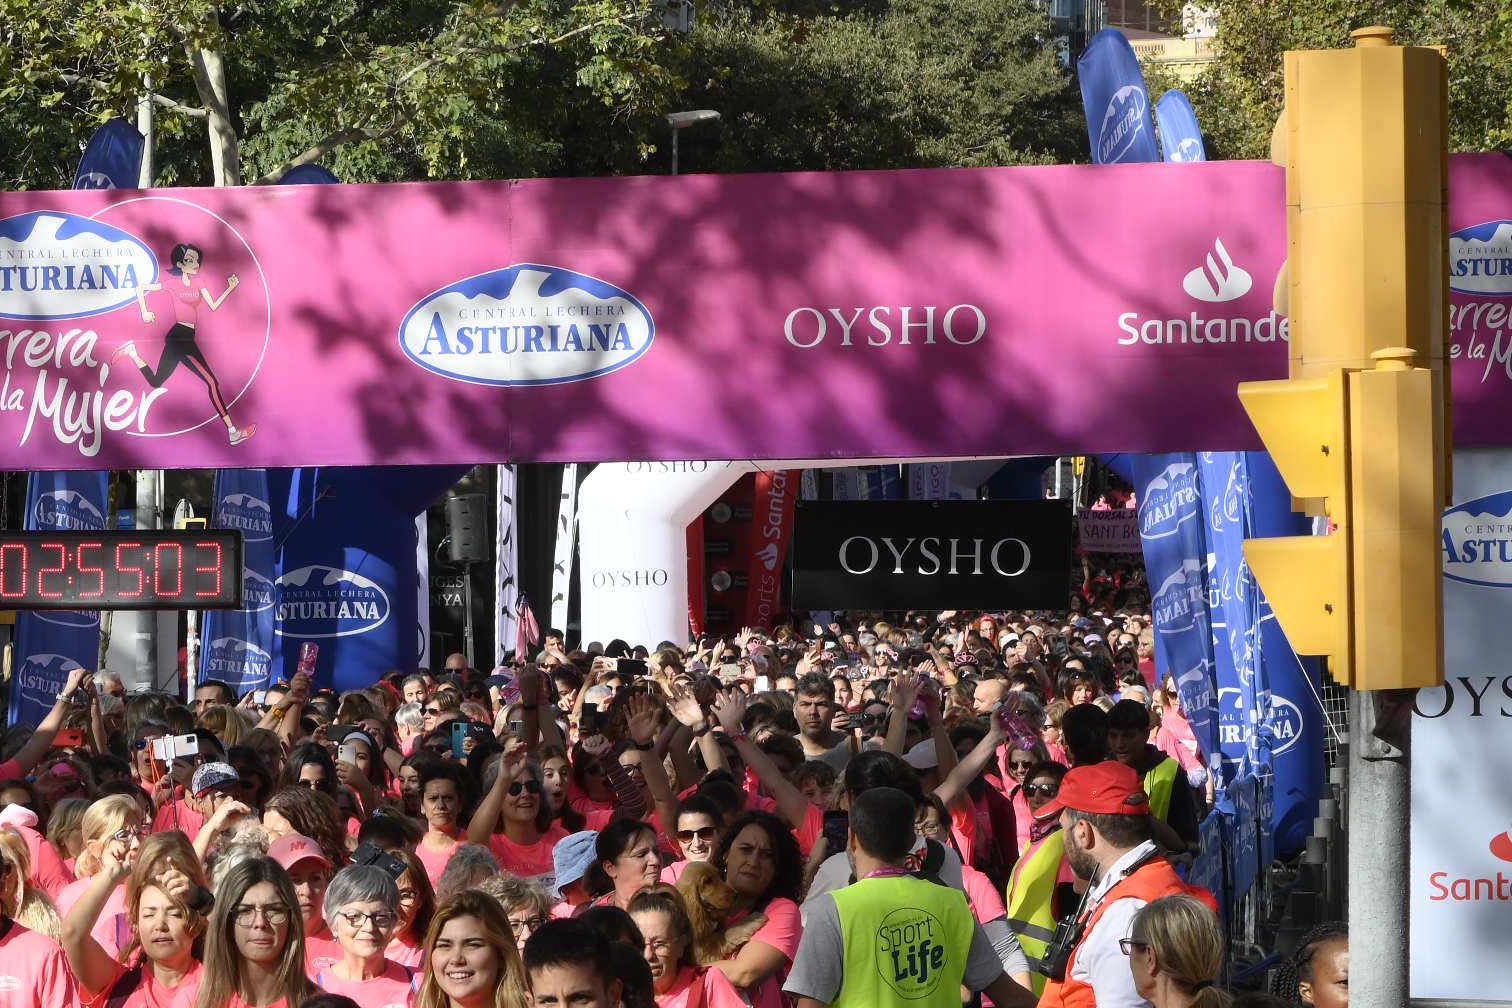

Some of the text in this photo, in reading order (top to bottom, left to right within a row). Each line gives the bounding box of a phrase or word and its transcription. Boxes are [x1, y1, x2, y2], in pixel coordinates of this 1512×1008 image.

[60, 247, 136, 260] LECHERA
[418, 311, 635, 355] ASTURIANA
[458, 304, 627, 319] CENTRAL LECHERA
[784, 303, 987, 348] OYSHO
[1118, 311, 1289, 345] Santande
[0, 371, 25, 411] la
[19, 365, 168, 457] Mujer
[0, 542, 222, 598] 02:55:03
[839, 535, 1032, 578] OYSHO
[592, 569, 668, 588] OYSHO
[879, 916, 934, 952] Sport
[891, 940, 944, 984] Life
